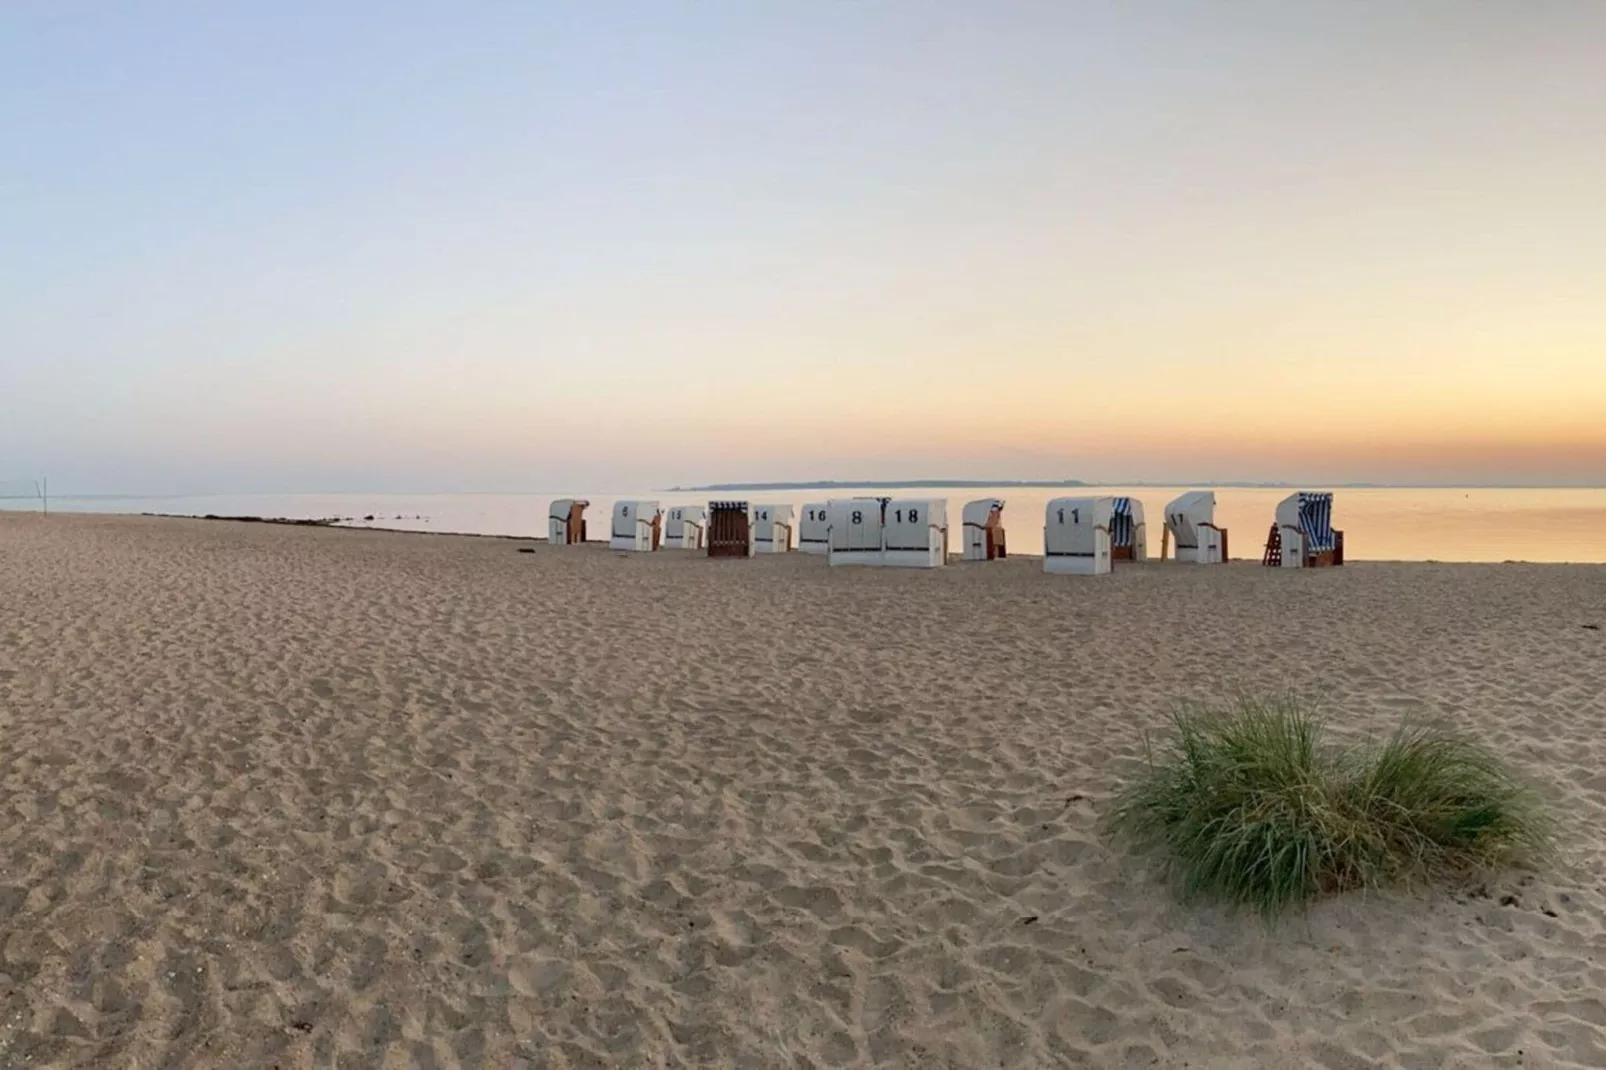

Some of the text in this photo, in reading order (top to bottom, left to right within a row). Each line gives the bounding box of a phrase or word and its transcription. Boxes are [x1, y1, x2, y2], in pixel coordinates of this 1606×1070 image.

[755, 510, 768, 521] 14
[809, 510, 826, 522] 16
[852, 510, 862, 525] 8
[895, 509, 918, 524] 18
[1057, 508, 1079, 525] 11
